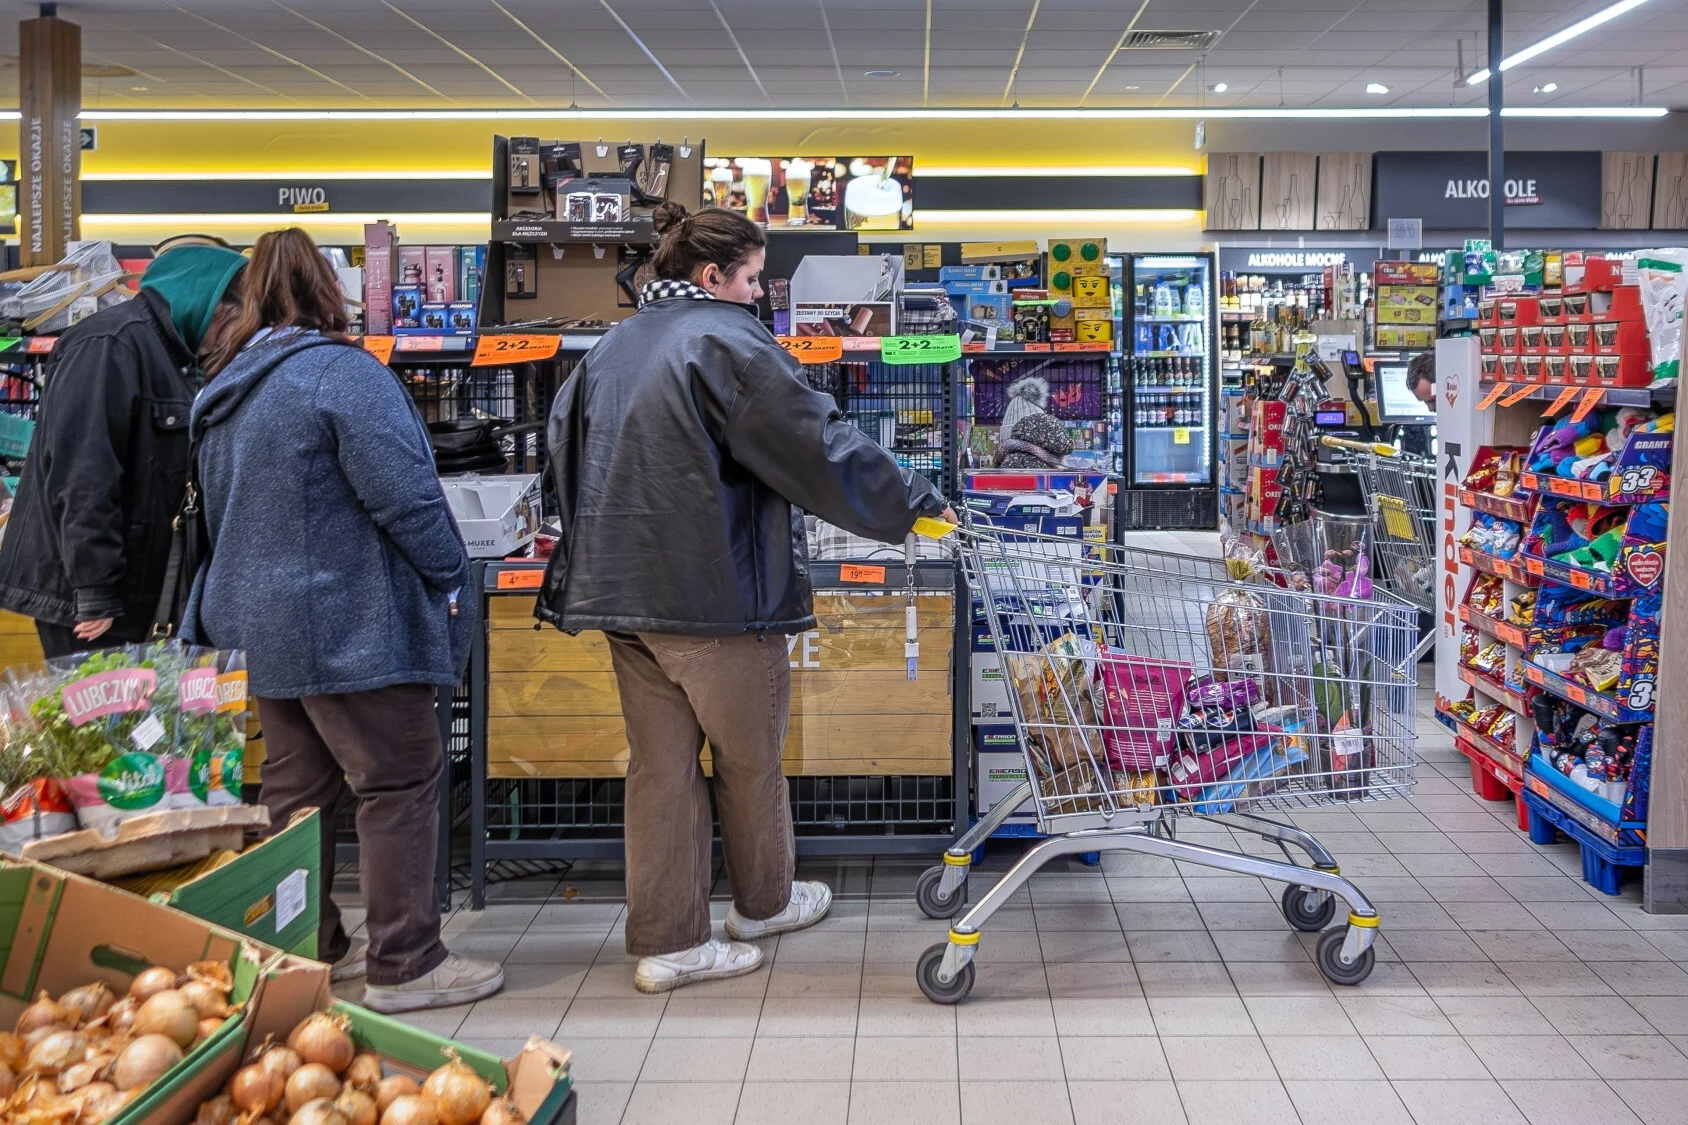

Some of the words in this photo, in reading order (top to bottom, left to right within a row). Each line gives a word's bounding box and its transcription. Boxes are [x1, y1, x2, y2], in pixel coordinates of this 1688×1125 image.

[31, 117, 43, 172] OKAZJE
[63, 119, 73, 173] OKAZJE
[279, 187, 326, 206] PIWO
[1445, 179, 1537, 199] ALKOOLE
[32, 174, 43, 253] NAJLEPSZE
[1248, 253, 1304, 266] ALKOHOLE
[496, 340, 530, 351] 2+2
[899, 340, 931, 350] 2+2
[1620, 465, 1658, 494] 33
[850, 570, 859, 580] 19
[785, 631, 820, 668] ZE
[66, 678, 140, 717] LUBCZYK
[1628, 675, 1658, 711] 3
